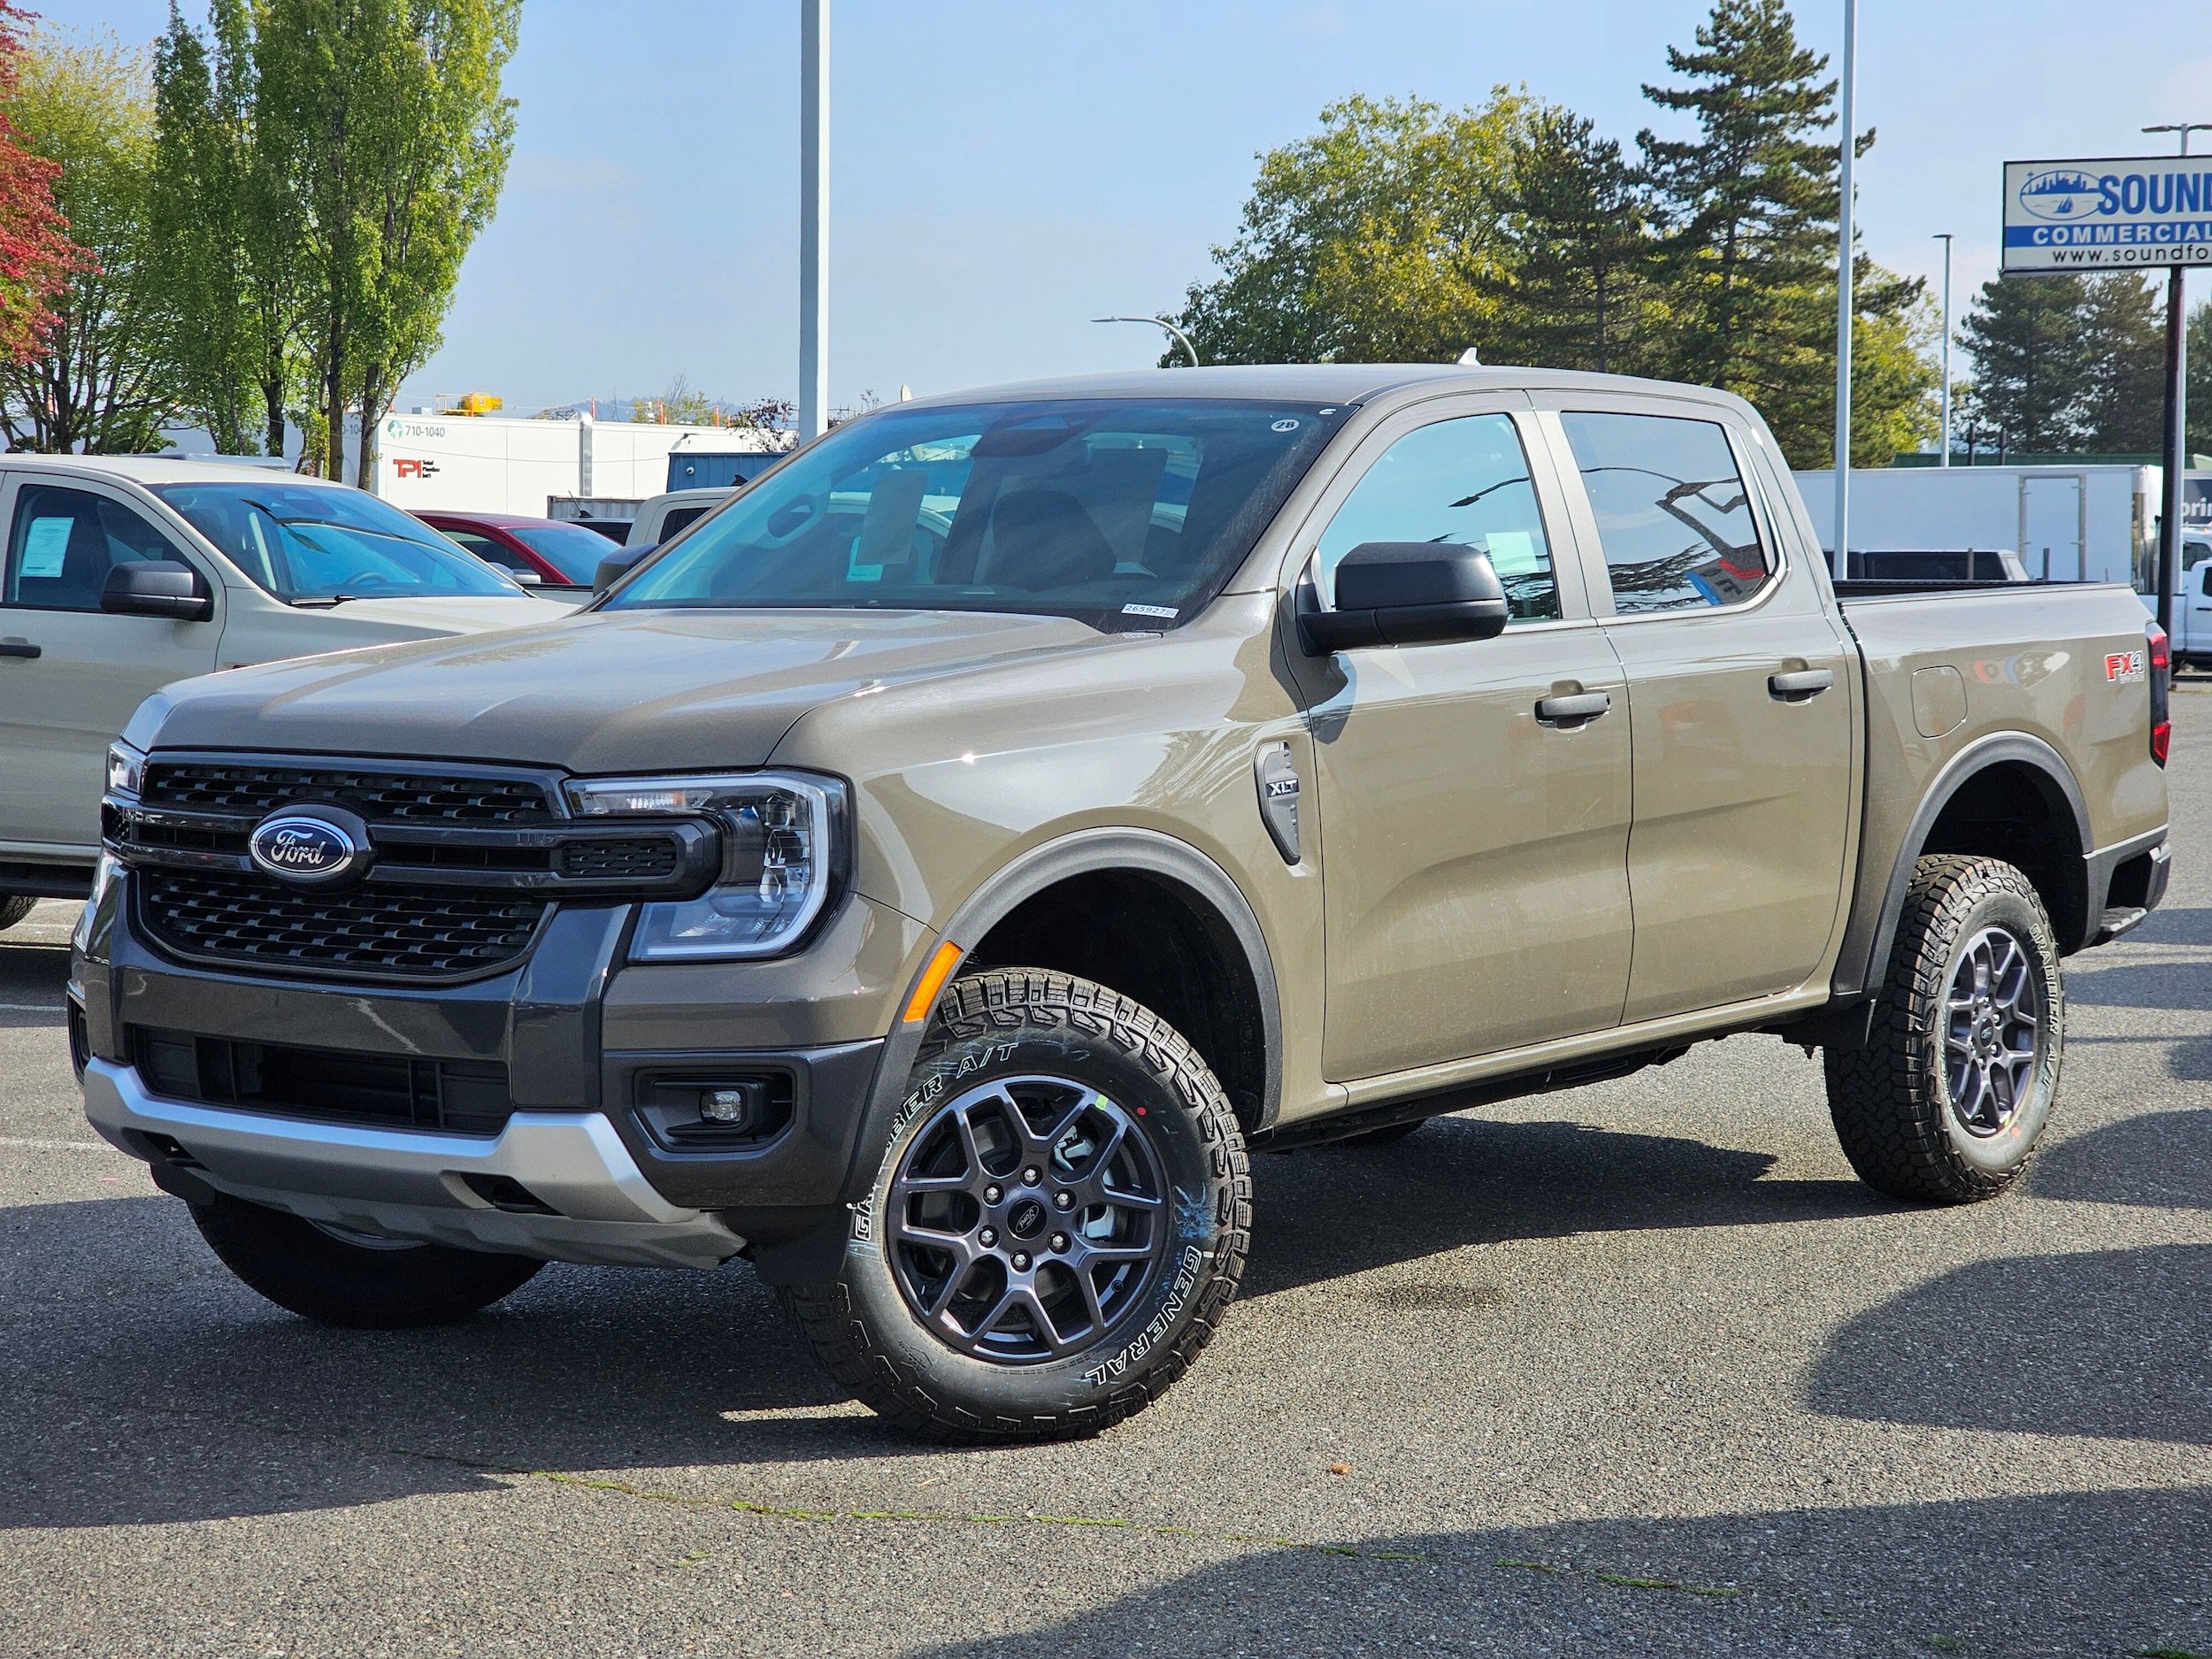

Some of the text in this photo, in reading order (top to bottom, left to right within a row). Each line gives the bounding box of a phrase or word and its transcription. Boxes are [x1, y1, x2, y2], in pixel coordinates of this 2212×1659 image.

[2052, 244, 2212, 263] www.soundfo
[405, 425, 445, 437] 710-1040
[393, 458, 422, 479] TPI
[1125, 605, 1166, 615] 265927
[2105, 650, 2145, 681] FX4
[1269, 779, 1298, 796] XLT
[270, 829, 326, 864] Ford
[956, 1042, 1019, 1079] A/T
[1018, 1209, 1036, 1229] Ford
[1084, 1245, 1203, 1386] GENERAL
